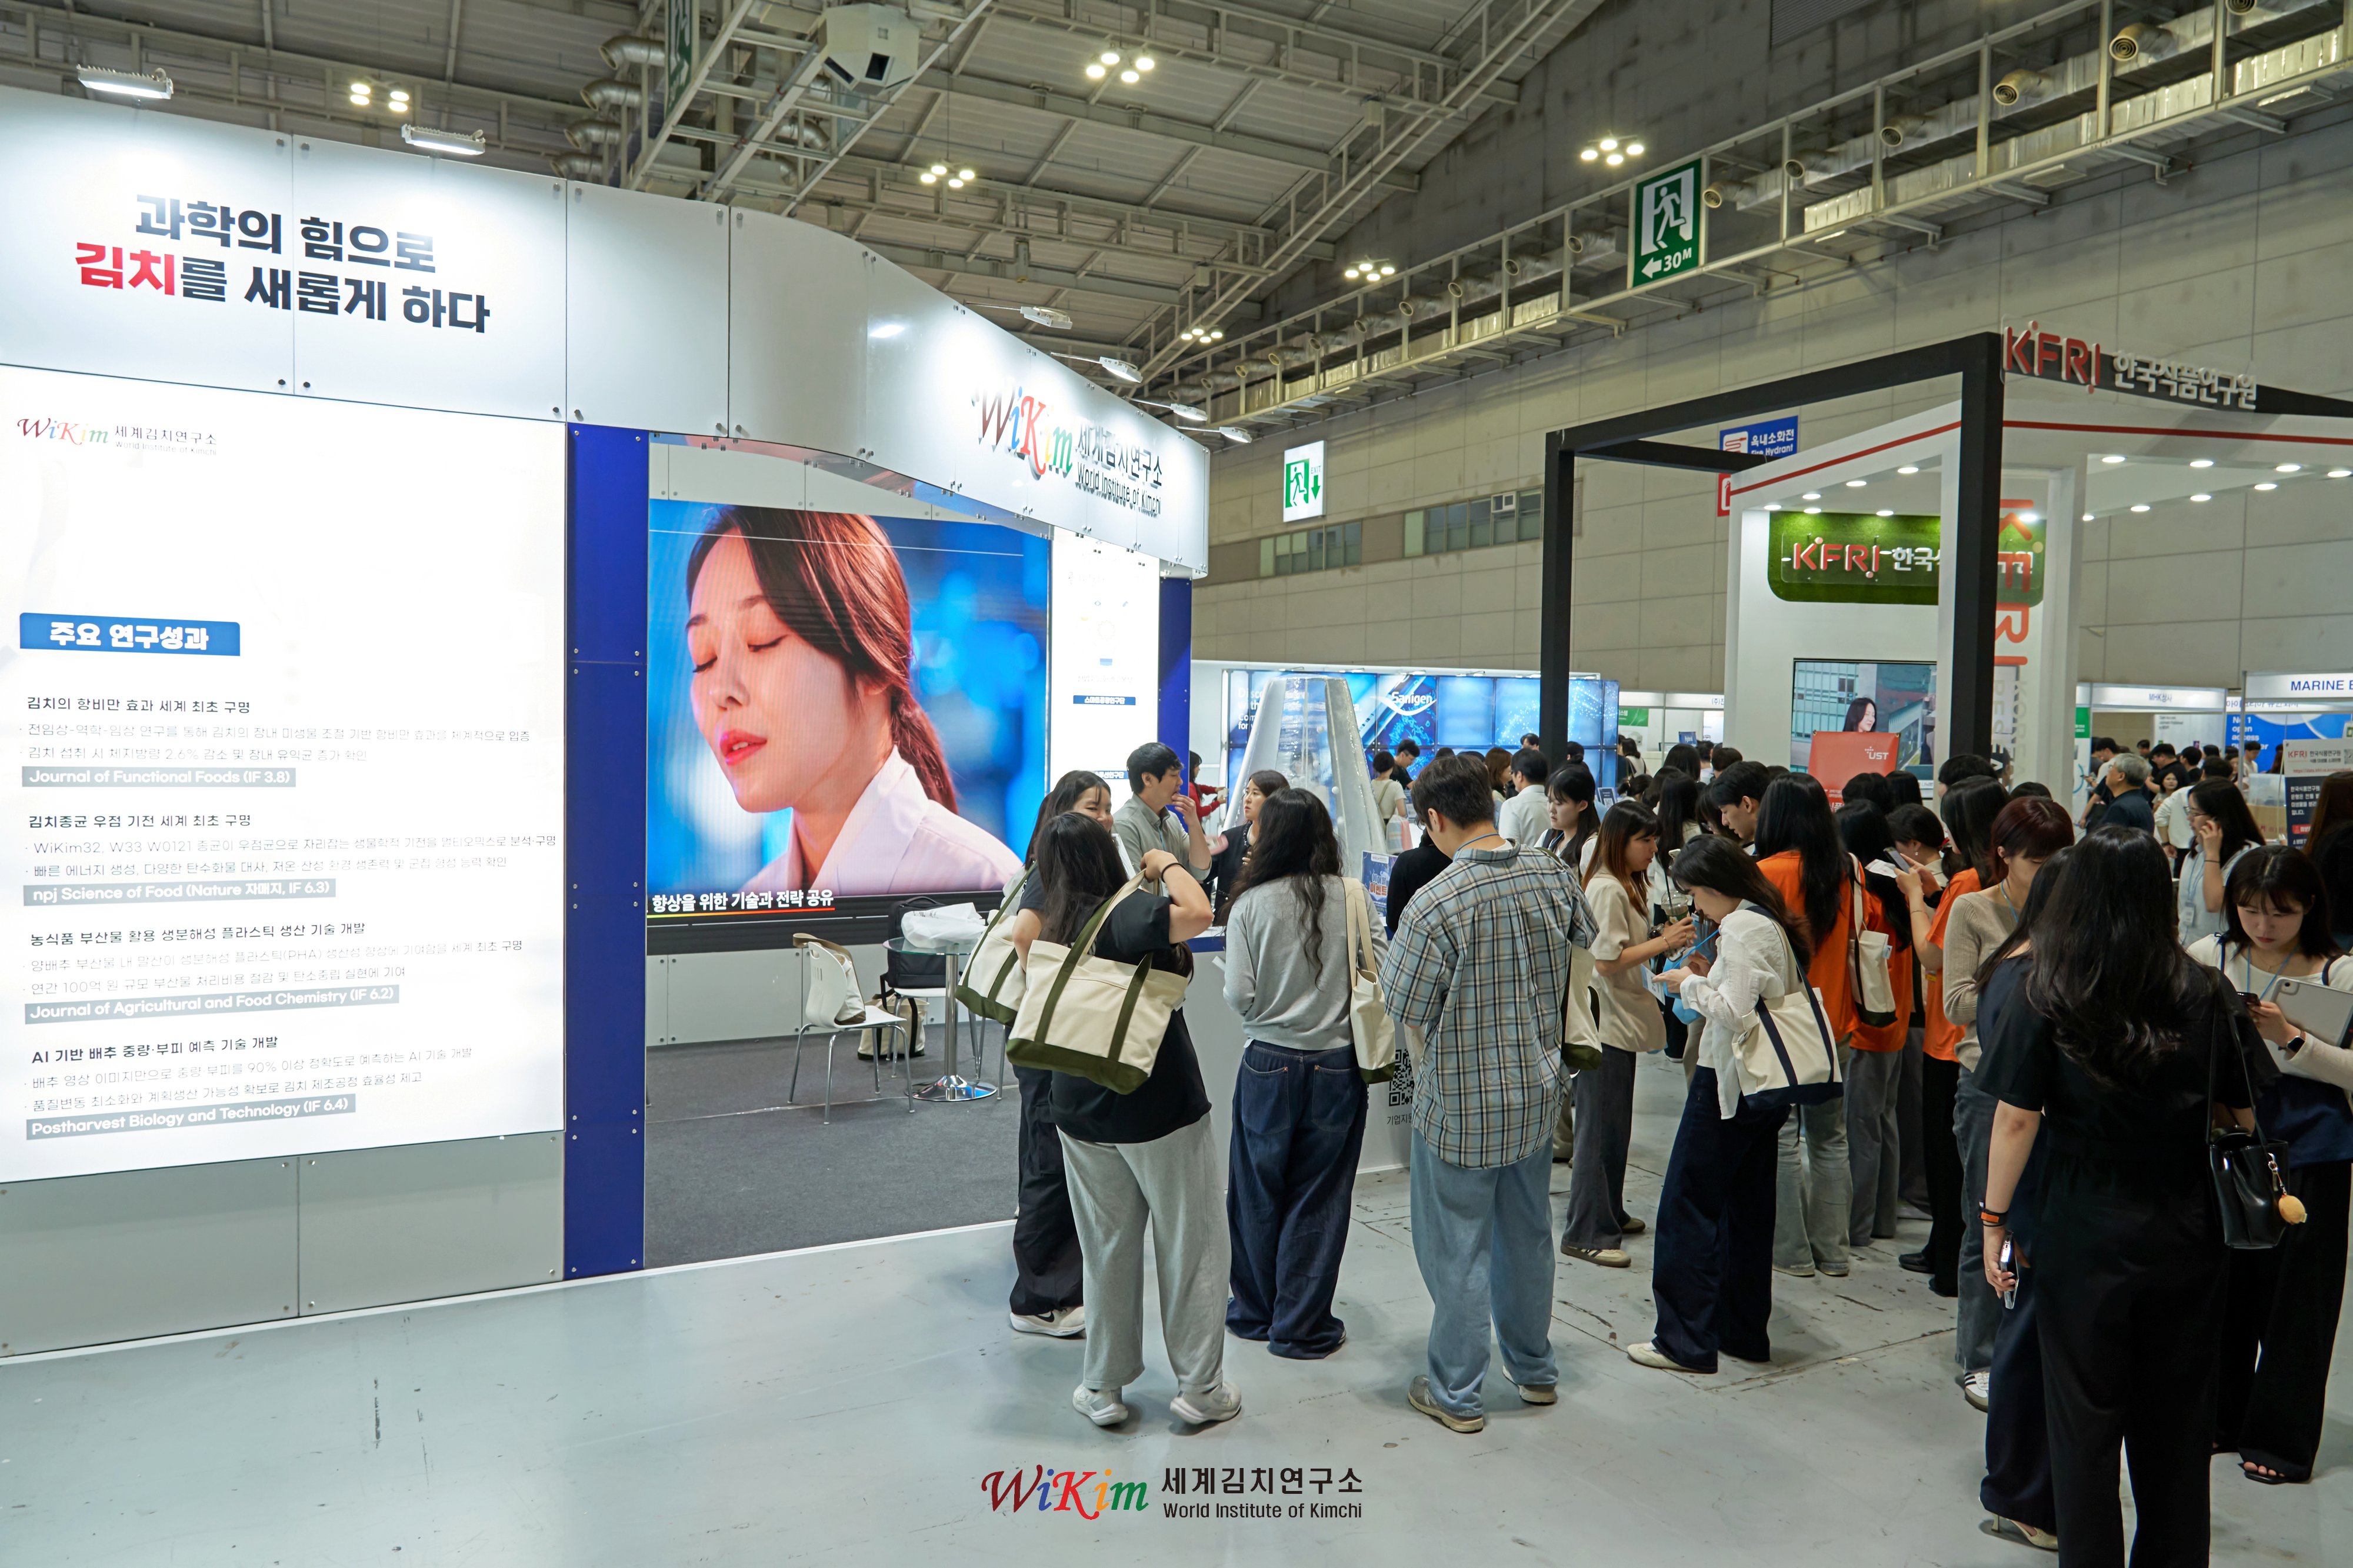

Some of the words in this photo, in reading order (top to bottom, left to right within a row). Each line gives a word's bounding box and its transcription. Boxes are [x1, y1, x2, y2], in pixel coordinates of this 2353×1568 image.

[135, 194, 281, 255] 과학의
[300, 215, 436, 273] 힘으로
[1664, 248, 1692, 272] 30M
[75, 242, 227, 302] 김치를
[244, 266, 386, 321] 새롭게
[402, 284, 491, 333] 하다
[2002, 325, 2101, 388] KFRI
[2114, 351, 2257, 409] 한국식품연구원
[17, 418, 108, 445] WiKim
[115, 426, 216, 445] 세계김치연구소
[971, 386, 1073, 475] WiKim
[1751, 429, 1794, 447] 옥내소화전
[142, 443, 176, 452] Institute
[1077, 423, 1162, 486] 세계김치연구소
[1765, 443, 1793, 456] Hydrant
[1311, 465, 1321, 474] EXIT
[1078, 462, 1099, 489] World
[1102, 474, 1130, 505] Institute
[1133, 488, 1139, 504] of
[1141, 489, 1161, 514] Kimchi
[1793, 541, 1879, 574] KFRI
[50, 622, 101, 645] 주요
[109, 624, 209, 650] 연구성과
[2291, 680, 2344, 691] MARINE
[28, 697, 70, 710] 김치의
[77, 698, 120, 711] 항비만
[126, 699, 154, 712] 효과
[159, 700, 186, 712] 세계
[192, 700, 218, 713] 최초
[224, 702, 249, 713] 구명
[1391, 692, 1432, 706] Sanigen
[28, 723, 135, 736] 전임상-역학-임상
[509, 731, 530, 742] 입증
[29, 747, 54, 759] 김치
[60, 748, 85, 759] 섭취
[249, 749, 272, 760] 장내
[29, 770, 89, 783] Journal
[95, 770, 111, 783] of
[114, 770, 191, 783] Functional
[195, 770, 239, 783] Foods
[243, 771, 261, 783] (IF
[264, 771, 290, 784] 3.8)
[29, 816, 87, 828] 김치종균
[94, 815, 121, 828] 우점
[128, 815, 154, 827] 기전
[161, 815, 187, 827] 세계
[193, 815, 219, 826] 최초
[225, 815, 251, 826] 구명
[34, 842, 104, 853] WiKim32,
[109, 841, 142, 853] W33
[238, 839, 298, 850] 우점균으로
[511, 836, 556, 846] 분석·구명
[34, 865, 60, 877] 빠른
[66, 865, 104, 876] 에너지
[110, 864, 139, 876] 생성,
[144, 863, 182, 875] 다양한
[187, 862, 236, 874] 탄수화물
[241, 862, 268, 873] 대사,
[272, 860, 324, 872] 저온·산성
[34, 889, 58, 903] npj
[61, 888, 122, 900] Science
[127, 886, 142, 899] of
[145, 885, 182, 898] Food
[186, 884, 241, 897] (Nature
[245, 883, 285, 895] 자매지,
[289, 882, 301, 894] IF
[305, 880, 329, 894] 6.3)
[652, 894, 695, 912] 향상을
[699, 892, 728, 910] 위한
[731, 891, 773, 909] 기술과
[776, 890, 804, 907] 전략
[806, 889, 834, 906] 공유
[1369, 882, 1388, 896] 이벤트
[31, 933, 74, 946] 농식품
[80, 931, 122, 945] 부산물
[129, 930, 155, 943] 활용
[161, 928, 215, 941] 생분해성
[222, 926, 274, 939] 플라스틱
[280, 925, 305, 937] 생산
[311, 923, 335, 935] 기술
[341, 923, 365, 934] 개발
[31, 959, 71, 972] 양배추
[477, 941, 498, 952] 최초
[502, 940, 522, 951] 구명
[31, 983, 58, 995] 연간
[31, 1006, 91, 1019] Journal
[95, 1002, 111, 1015] of
[114, 997, 201, 1017] Agricultural
[205, 994, 232, 1008] and
[236, 993, 271, 1007] Food
[275, 988, 347, 1006] Chemistry
[350, 987, 367, 1000] (IF
[370, 986, 394, 1000] 6.2)
[32, 1051, 48, 1064] AI
[55, 1049, 84, 1062] 기반
[89, 1046, 117, 1059] 배추
[122, 1043, 182, 1057] 중량·부피
[189, 1040, 215, 1053] 예측
[221, 1038, 246, 1050] 기술
[252, 1036, 278, 1049] 개발
[33, 1076, 58, 1089] 배추
[64, 1074, 90, 1087] 영상
[409, 1051, 421, 1062] AI
[451, 1047, 472, 1059] 개발
[33, 1097, 85, 1112] 품질변동
[91, 1093, 143, 1107] 최소화와
[148, 1089, 198, 1102] 계획생산
[203, 1086, 239, 1098] 가능성
[244, 1083, 279, 1095] 확보로
[285, 1080, 306, 1092] 김치
[312, 1077, 357, 1090] 제조공정
[362, 1074, 395, 1086] 효율성
[400, 1072, 422, 1083] 제고
[32, 1117, 125, 1135] Postharvest
[129, 1110, 183, 1127] Biology
[188, 1108, 216, 1122] and
[220, 1102, 300, 1117] Technology
[304, 1100, 321, 1113] (IF
[324, 1098, 348, 1112] 6.4)
